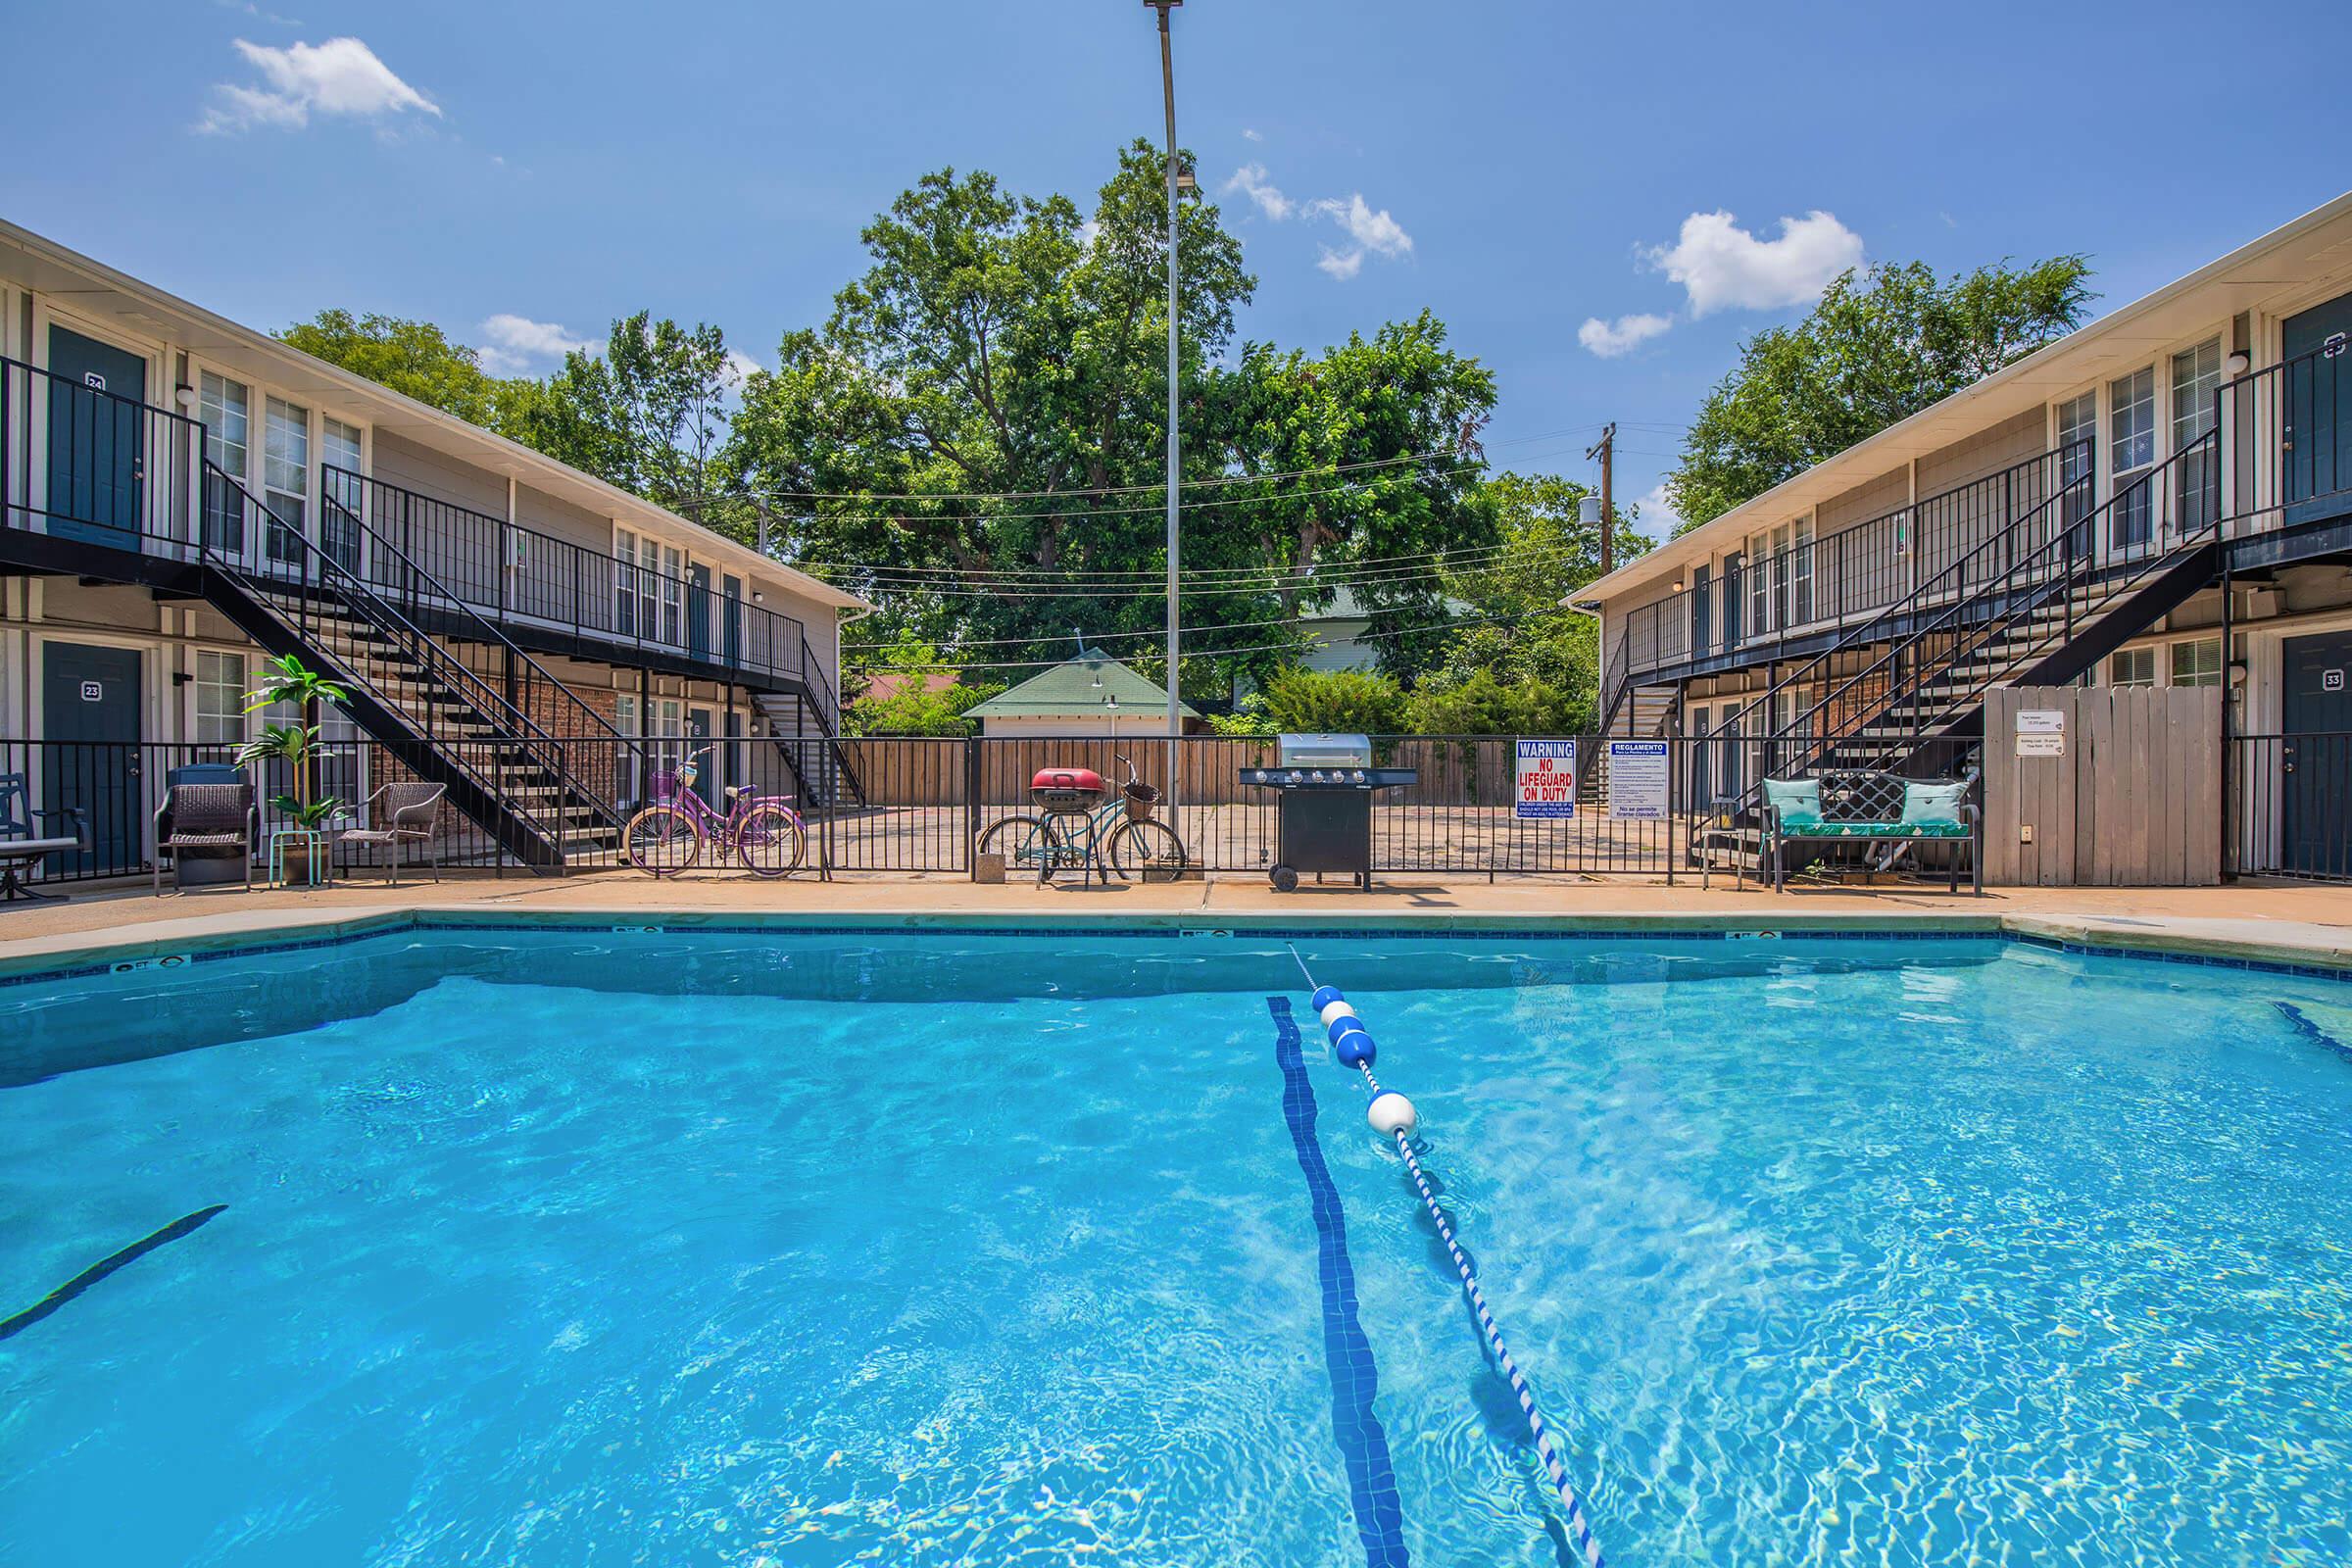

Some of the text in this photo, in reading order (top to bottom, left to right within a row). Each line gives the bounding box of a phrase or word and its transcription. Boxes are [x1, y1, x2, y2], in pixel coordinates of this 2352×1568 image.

[89, 378, 102, 390] 24
[2328, 675, 2340, 684] 33
[86, 687, 98, 696] 23
[1520, 743, 1573, 758] WARNING
[1540, 759, 1553, 772] NO
[1520, 772, 1572, 787] LIFEGUARD
[1524, 787, 1567, 801] ON DUTY
